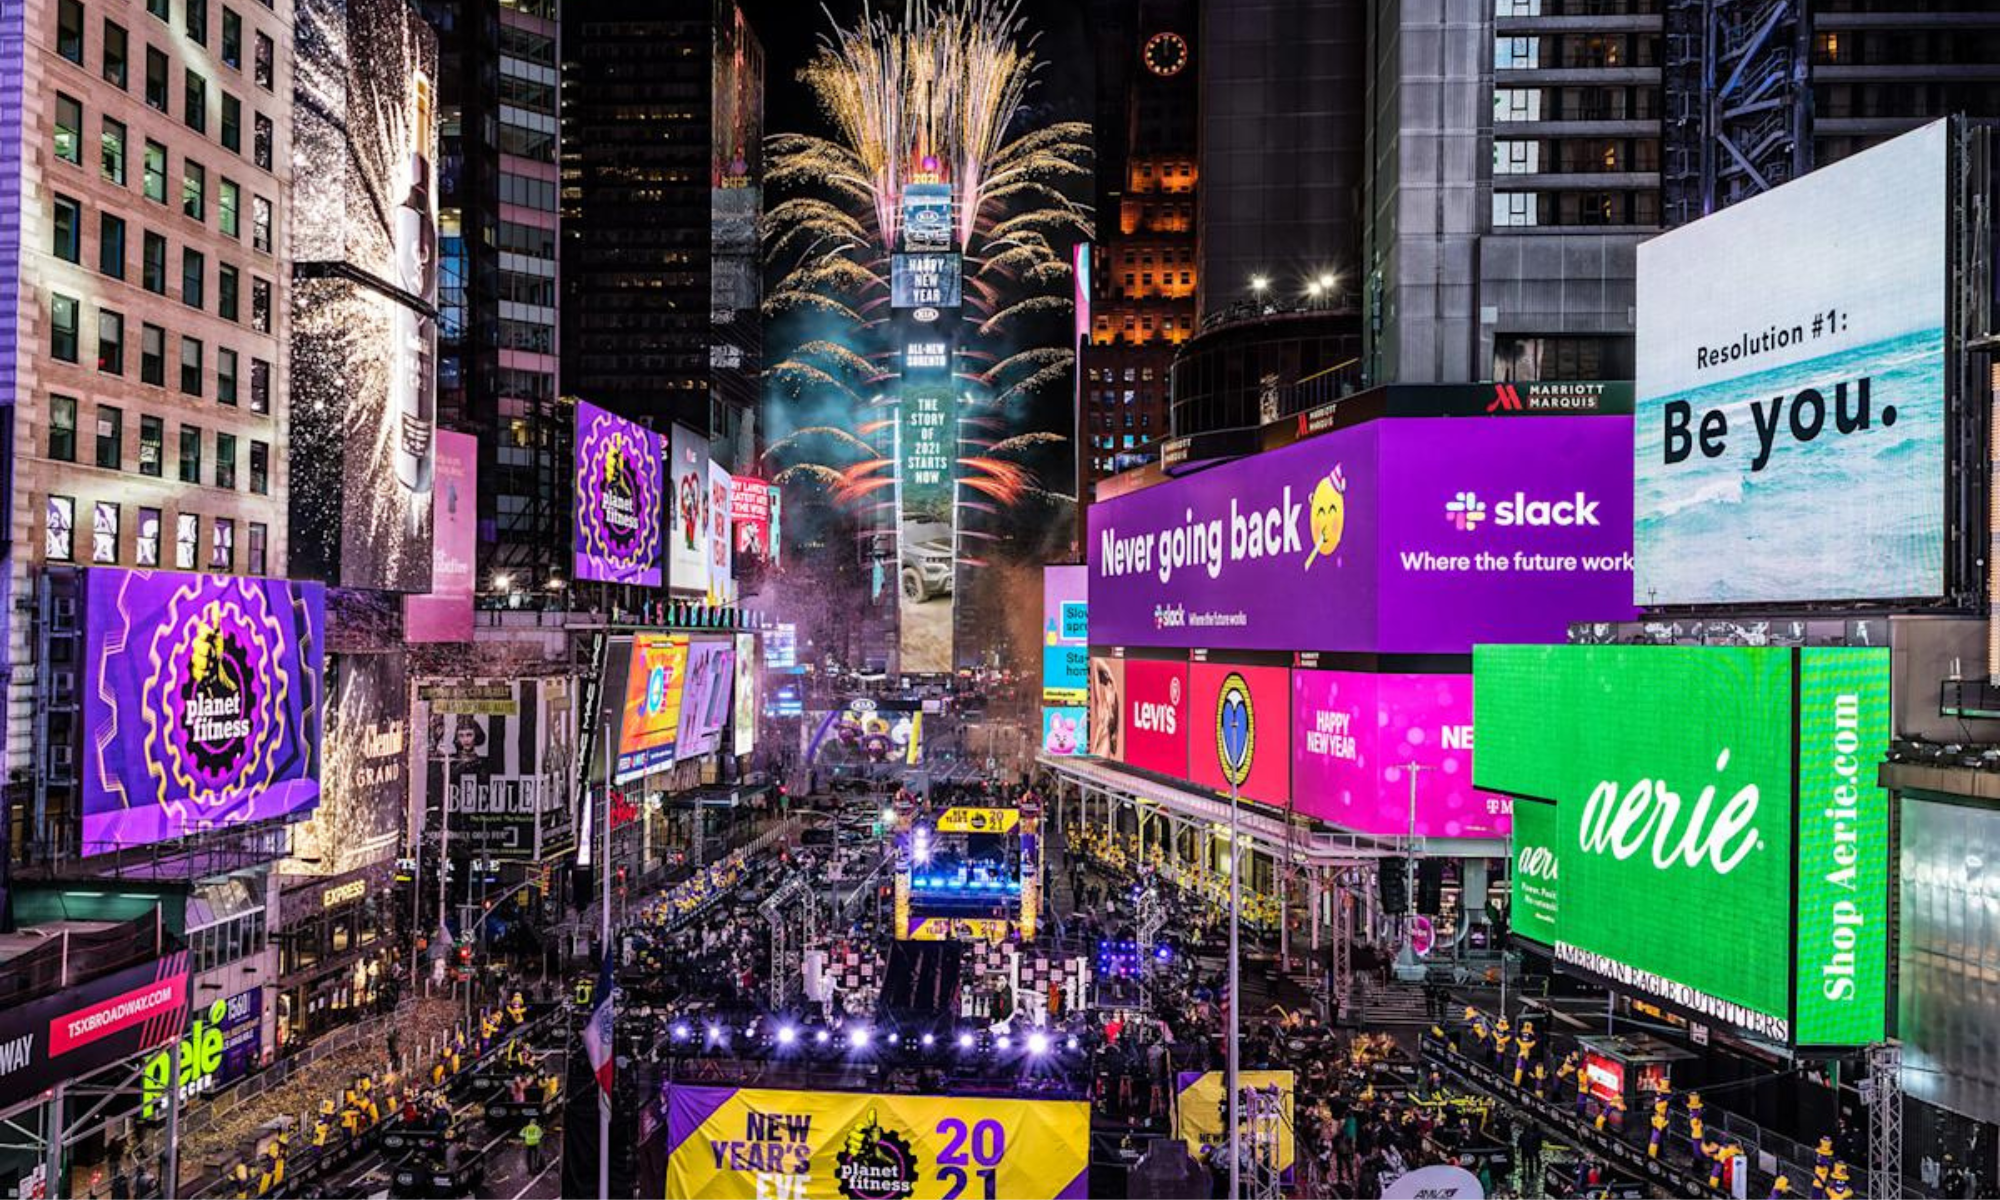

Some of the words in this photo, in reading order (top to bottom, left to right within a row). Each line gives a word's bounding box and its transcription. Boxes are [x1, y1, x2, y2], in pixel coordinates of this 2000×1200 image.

[908, 259, 945, 271] HAPPY
[914, 274, 939, 287] NEW
[913, 289, 941, 302] YEAR
[1696, 327, 1803, 370] Resolution
[1811, 309, 1849, 337] #1:
[1529, 384, 1605, 395] MARRIOTT
[917, 399, 939, 411] THE
[1529, 397, 1597, 408] MARQUIS
[911, 413, 945, 426] STORY
[1664, 399, 1728, 466] Be
[1750, 375, 1899, 473] you.
[921, 427, 935, 440] OF
[914, 442, 941, 455] 2021
[907, 457, 948, 470] STARTS
[914, 471, 940, 484] NOW
[601, 491, 633, 512] planet
[1494, 491, 1600, 527] slack
[605, 509, 639, 530] fitness
[1101, 527, 1154, 578] Never
[1158, 503, 1223, 584] going
[1231, 486, 1302, 562] back
[1400, 551, 1470, 571] Where
[1475, 551, 1509, 571] the
[1513, 551, 1578, 571] future
[1163, 602, 1185, 626] slack
[185, 692, 241, 720] planet
[192, 717, 250, 743] fitness
[1316, 710, 1350, 736] HAPPY
[1306, 730, 1329, 754] NEW
[1329, 733, 1357, 761] YEAR
[1441, 725, 1474, 750] NE
[356, 763, 400, 788] GRAND
[1824, 692, 1859, 891] Aerie.com
[323, 879, 366, 907] EXPRESS
[1823, 901, 1864, 1002] Shop
[1554, 940, 1629, 984] AMERICAN
[1631, 968, 1679, 1002] EAGLE
[1681, 984, 1789, 1042] OUTFITTERS
[67, 985, 173, 1040] TSXBROADWAY.COM
[160, 1073, 213, 1109] SCCER
[746, 1111, 813, 1143] NEW
[935, 1118, 1007, 1166] 20
[710, 1140, 812, 1174] YEAR'S
[841, 1160, 899, 1180] planet
[755, 1173, 813, 1200] EVE
[848, 1175, 911, 1193] fitness
[935, 1166, 996, 1200] 21
